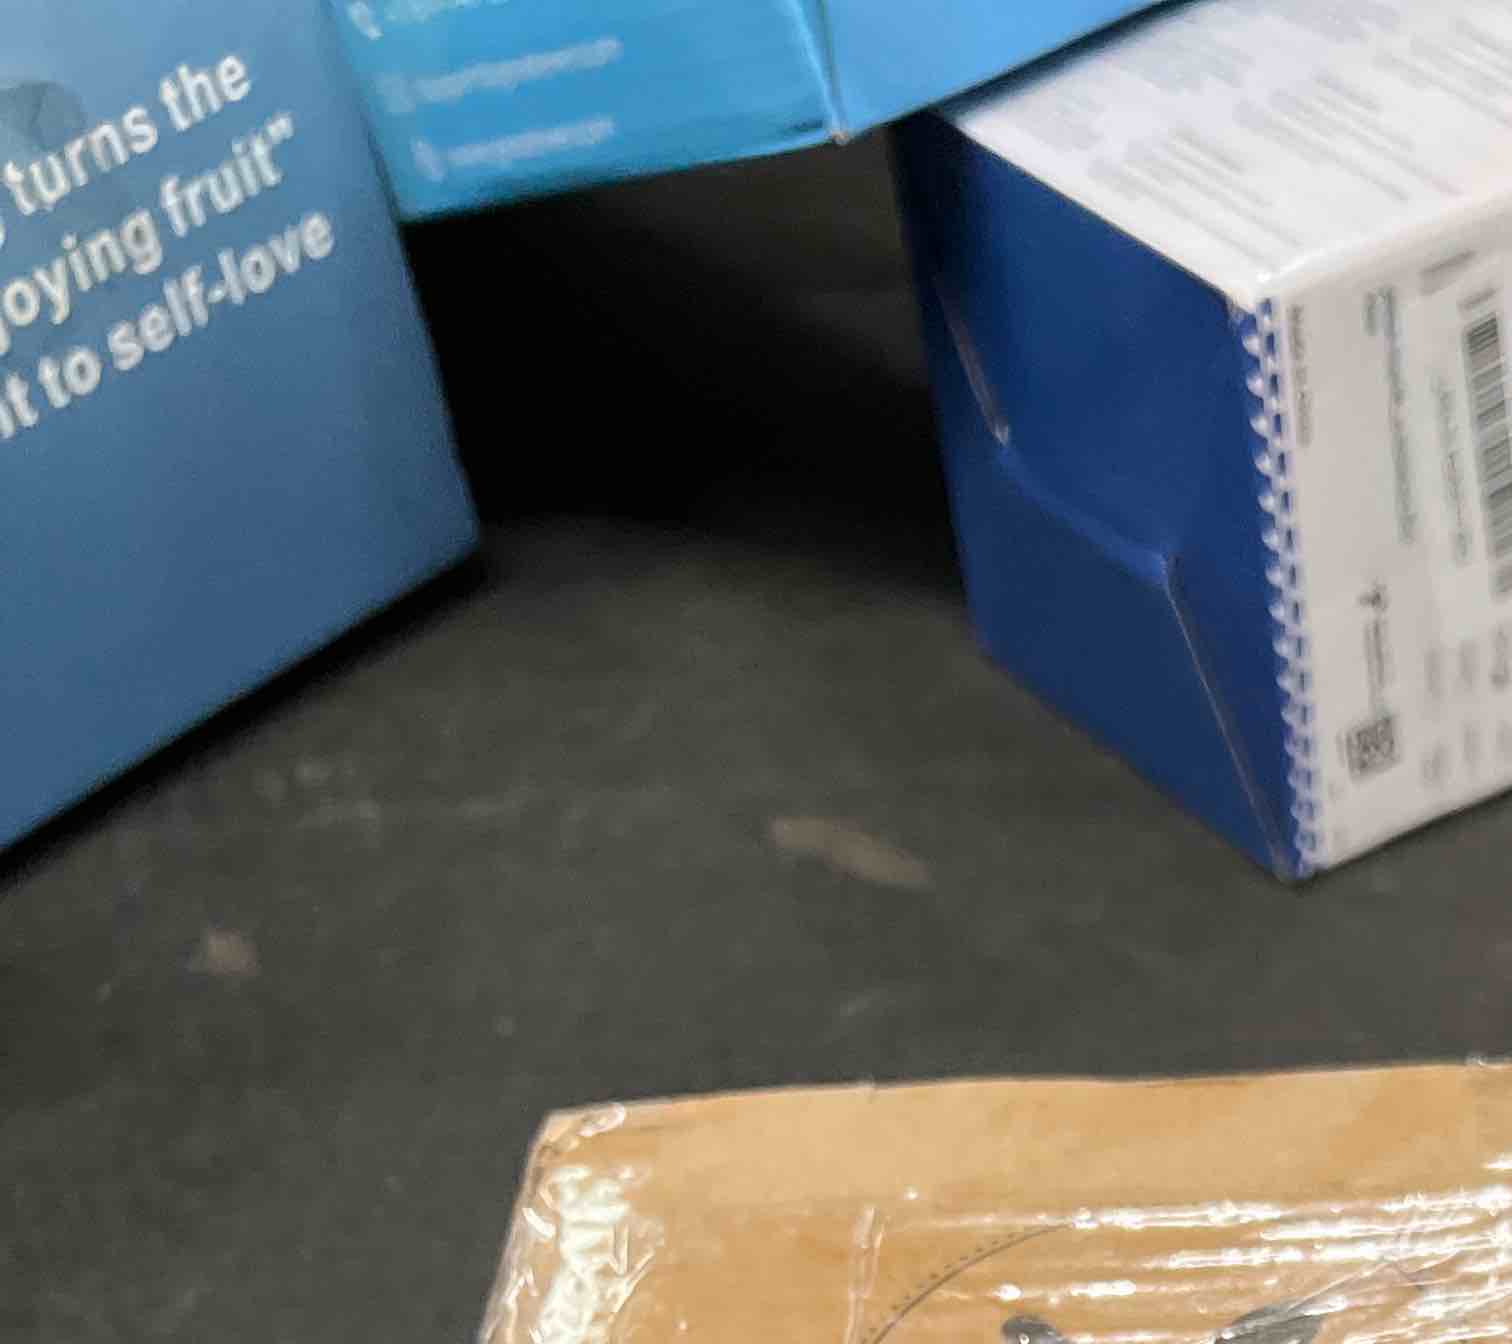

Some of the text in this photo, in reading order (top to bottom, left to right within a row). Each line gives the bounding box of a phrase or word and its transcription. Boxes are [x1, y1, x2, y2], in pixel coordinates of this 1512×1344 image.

[3, 54, 252, 216] turns the
[0, 207, 163, 357] oying
[37, 344, 102, 410] to
[106, 210, 335, 373] self-love
